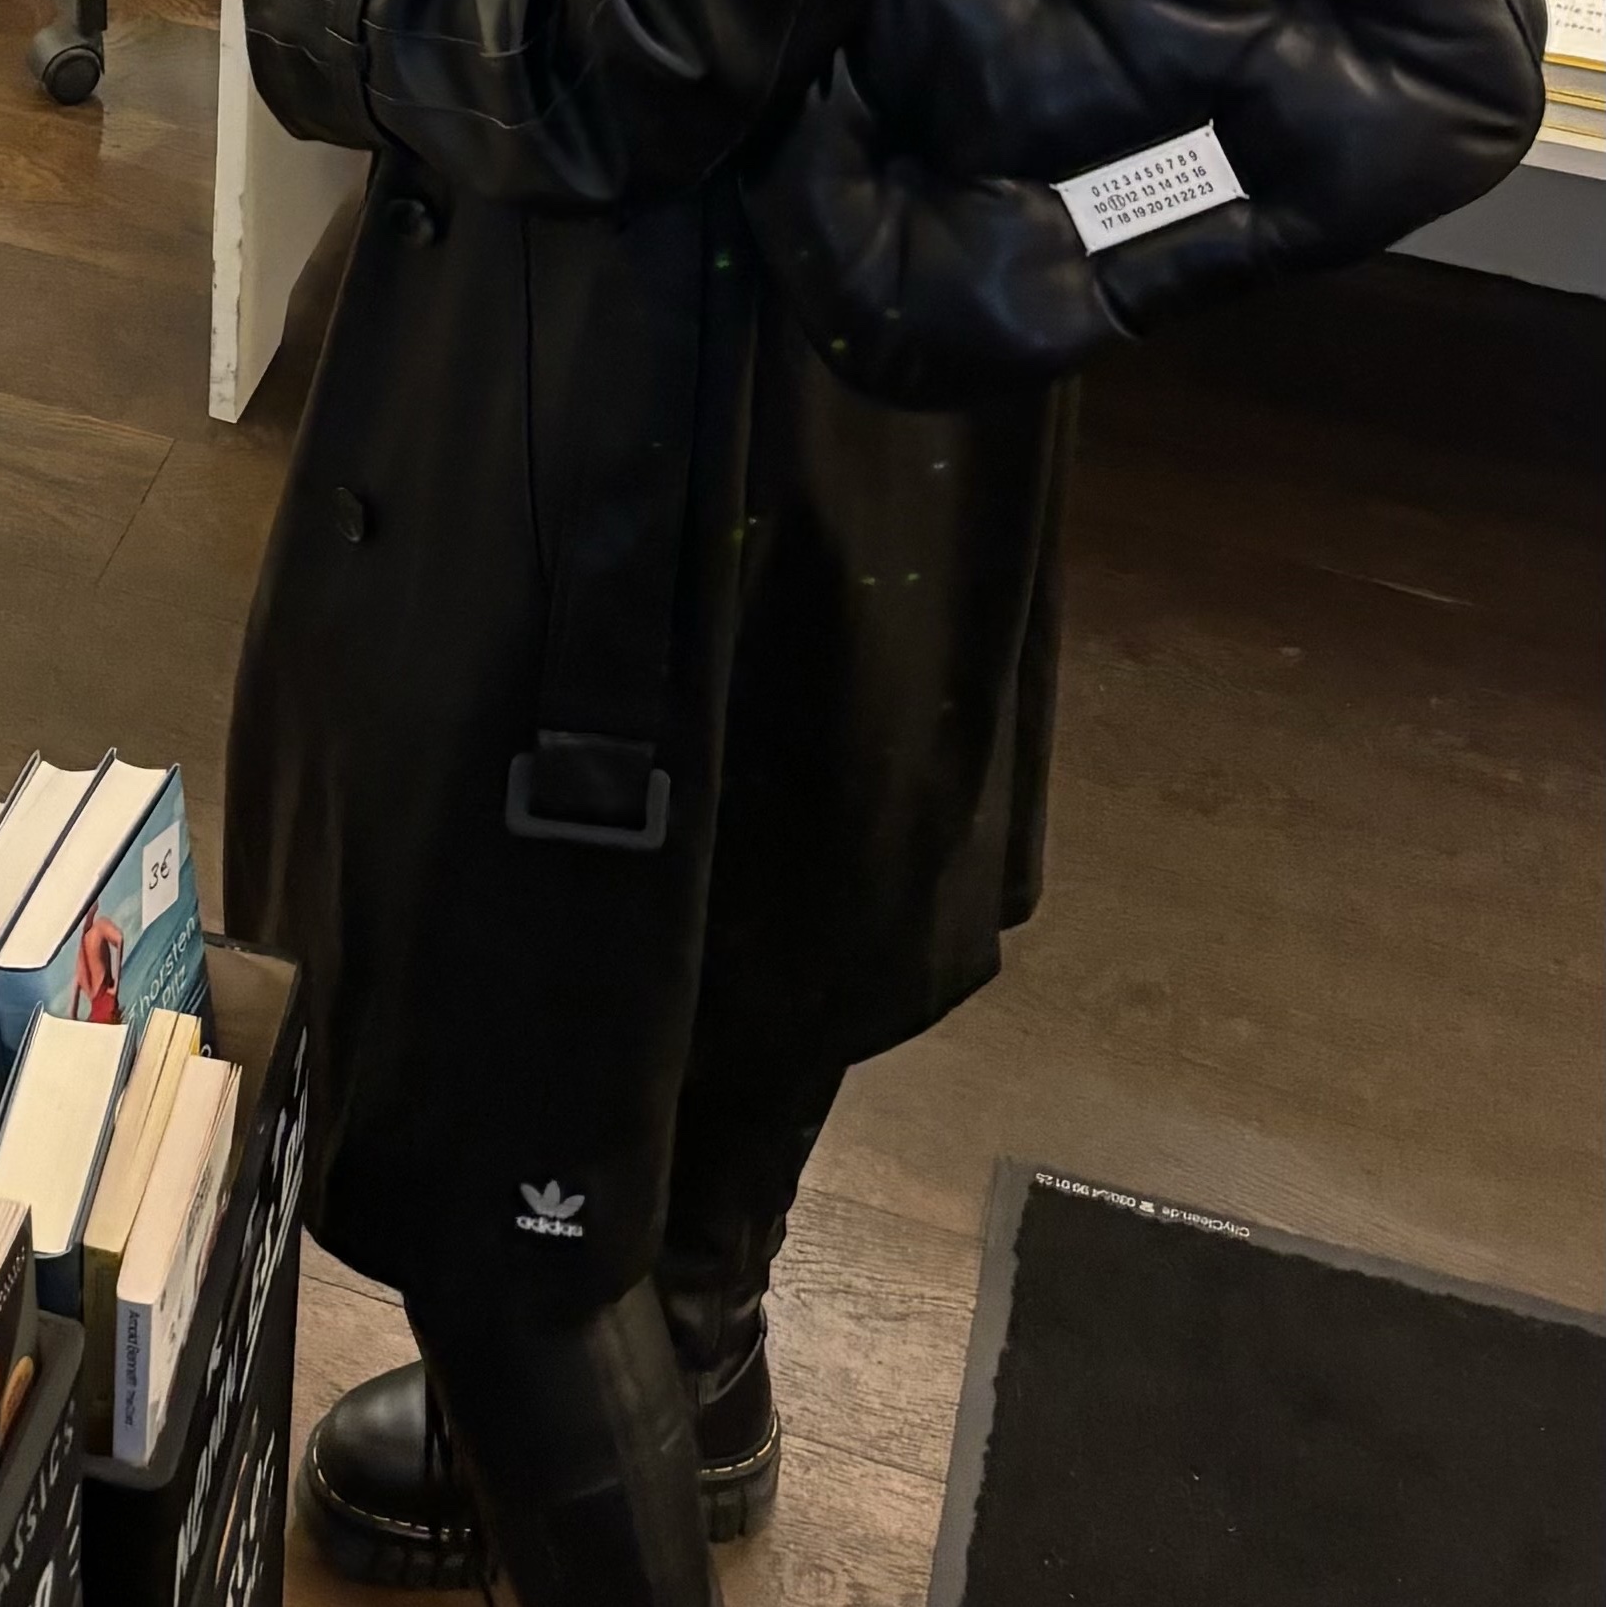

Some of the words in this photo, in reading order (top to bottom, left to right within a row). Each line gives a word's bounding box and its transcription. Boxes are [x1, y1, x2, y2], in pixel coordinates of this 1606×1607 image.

[1092, 186, 1099, 198] 0
[1102, 182, 1109, 193] 1
[1111, 179, 1121, 191] 2
[1123, 174, 1131, 186] 3
[1134, 171, 1142, 183] 4
[1144, 167, 1154, 178] 5
[1155, 162, 1164, 175] 6
[1166, 158, 1174, 170] 7
[1178, 154, 1187, 167] 8
[1189, 150, 1198, 162] 9
[1094, 201, 1108, 214] 10
[1110, 196, 1125, 210] 11
[1125, 191, 1139, 204] 12
[1143, 184, 1156, 197] 13
[1158, 178, 1173, 191] 14
[1175, 172, 1190, 185] 15
[1192, 165, 1207, 179] 16
[1101, 217, 1114, 231] 17
[1117, 211, 1131, 225] 18
[1132, 206, 1146, 220] 19
[1149, 201, 1164, 214] 20
[1165, 195, 1180, 209] 21
[1180, 189, 1196, 202] 22
[1197, 181, 1214, 196] 23
[515, 1215, 584, 1237] adidas
